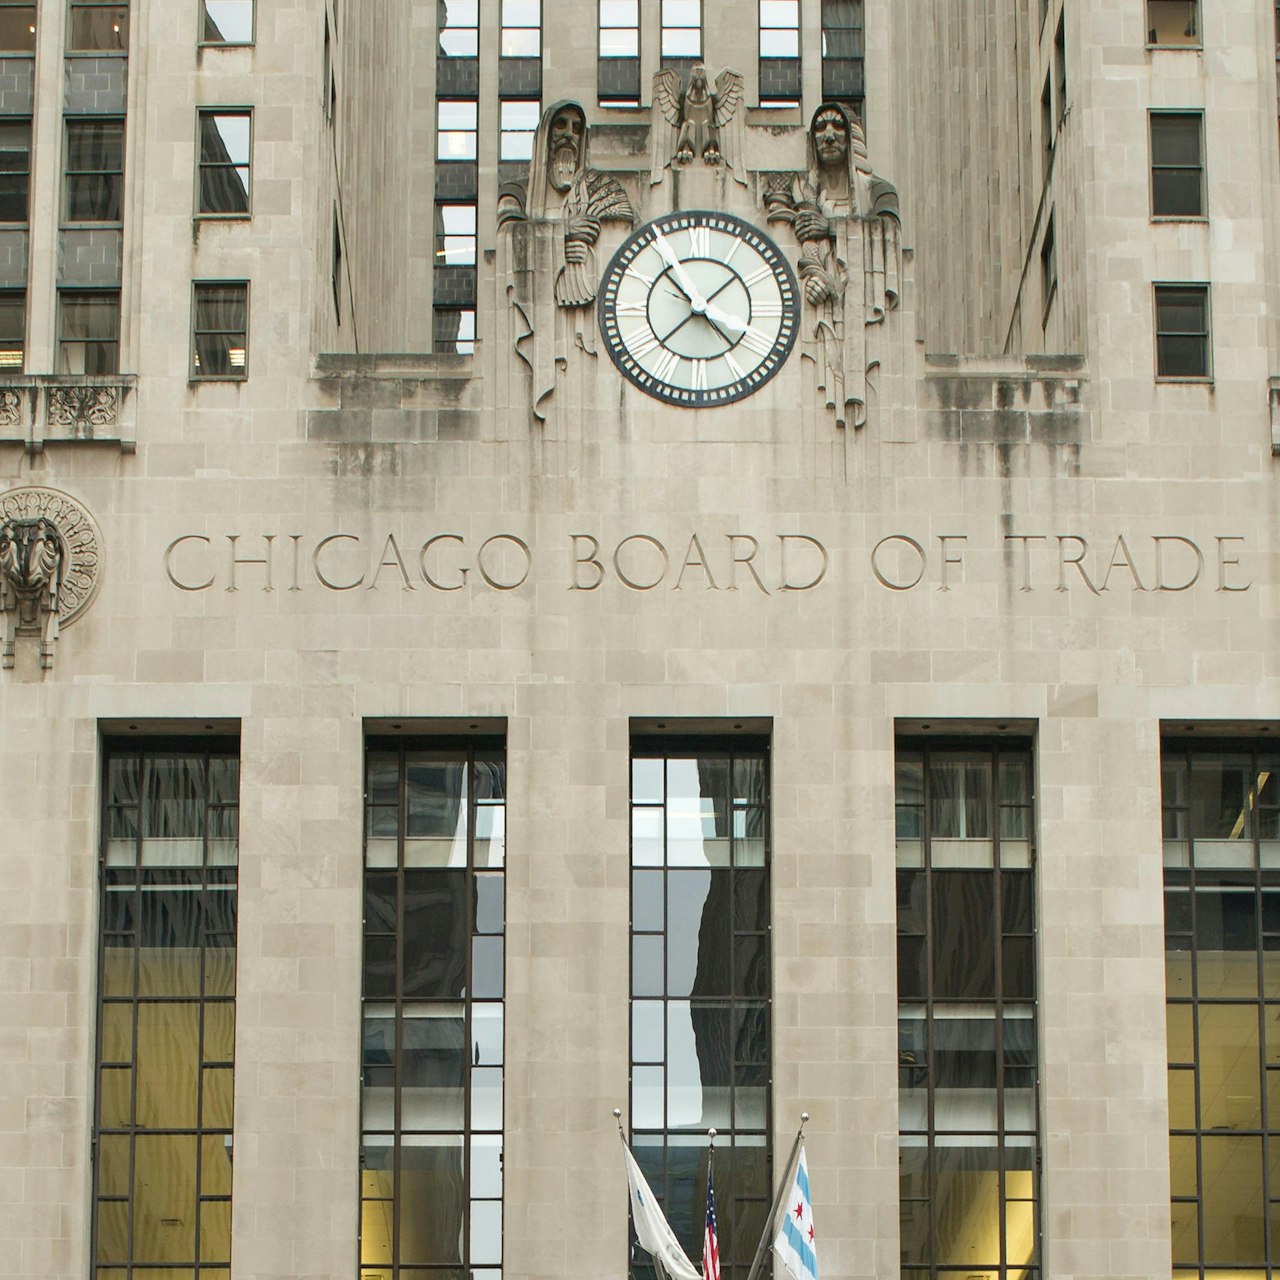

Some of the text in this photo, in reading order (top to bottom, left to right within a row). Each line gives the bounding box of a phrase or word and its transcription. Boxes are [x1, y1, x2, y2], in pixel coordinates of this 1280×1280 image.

[163, 533, 1253, 596] CHICAGO BOARD OF TRADE
